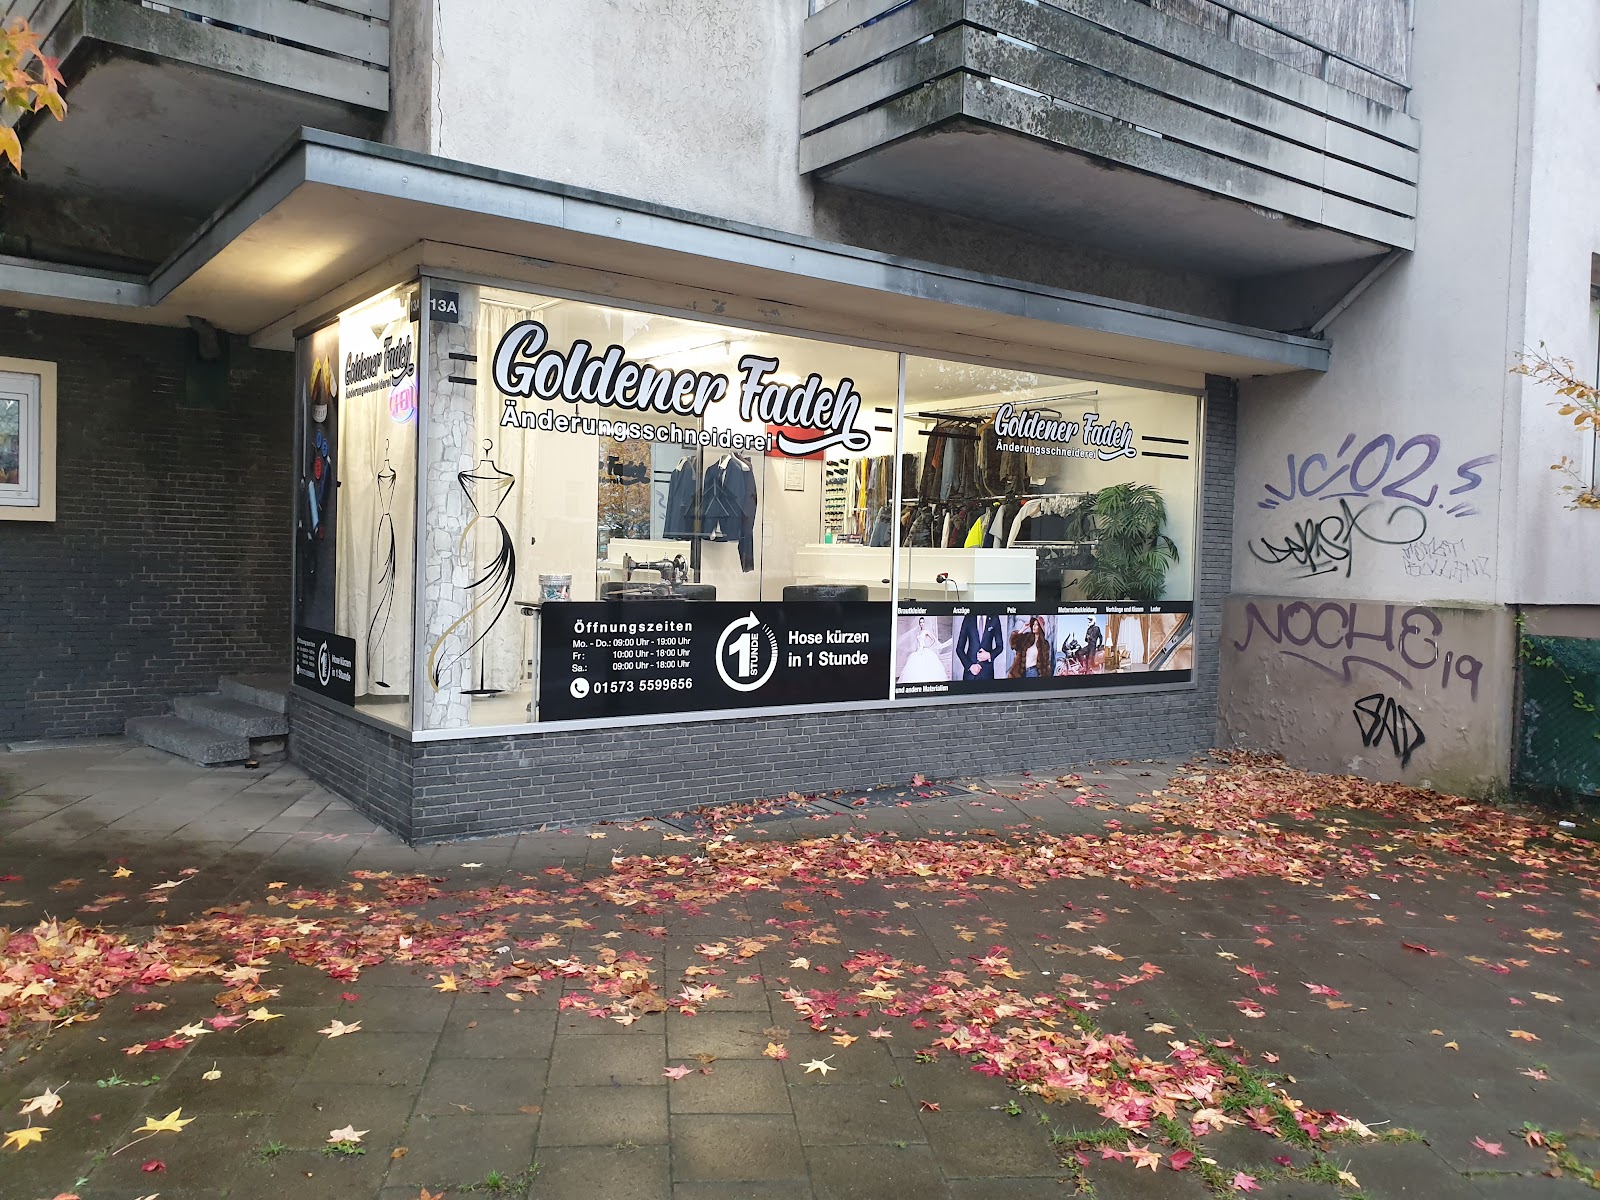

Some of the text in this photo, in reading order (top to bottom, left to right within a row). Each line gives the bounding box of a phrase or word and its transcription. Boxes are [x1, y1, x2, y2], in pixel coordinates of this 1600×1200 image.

[430, 298, 458, 314] 13A
[345, 351, 382, 386] Goldener
[492, 319, 872, 456] Goldener Faden
[500, 400, 773, 452] Änderungsschneiderei
[994, 402, 1138, 462] Goldener Faden
[995, 438, 1097, 460] Änderungsschneiderei
[952, 606, 971, 615] Anzüge
[573, 618, 693, 635] Öffnungszeiten
[572, 639, 588, 648] Mo.
[595, 639, 612, 648] Do.:
[612, 638, 635, 647] 09:00
[635, 637, 650, 646] Uhr
[656, 637, 677, 646] 19:00
[678, 636, 692, 645] Uhr
[788, 629, 870, 644] Hose kürzen
[612, 650, 634, 659] 10:00
[635, 649, 650, 658] Uhr
[655, 648, 676, 657] 18:00
[677, 648, 691, 657] Uhr
[728, 632, 751, 678] 1
[750, 632, 759, 676] STUNDE
[788, 650, 869, 667] in 1 Stunde
[571, 663, 588, 673] Sa.:
[612, 662, 634, 671] 09:00
[635, 661, 650, 670] Uhr
[655, 660, 676, 669] 18:00
[677, 660, 691, 668] Uhr
[593, 678, 693, 694] 01573 5599656
[905, 685, 922, 693] andere
